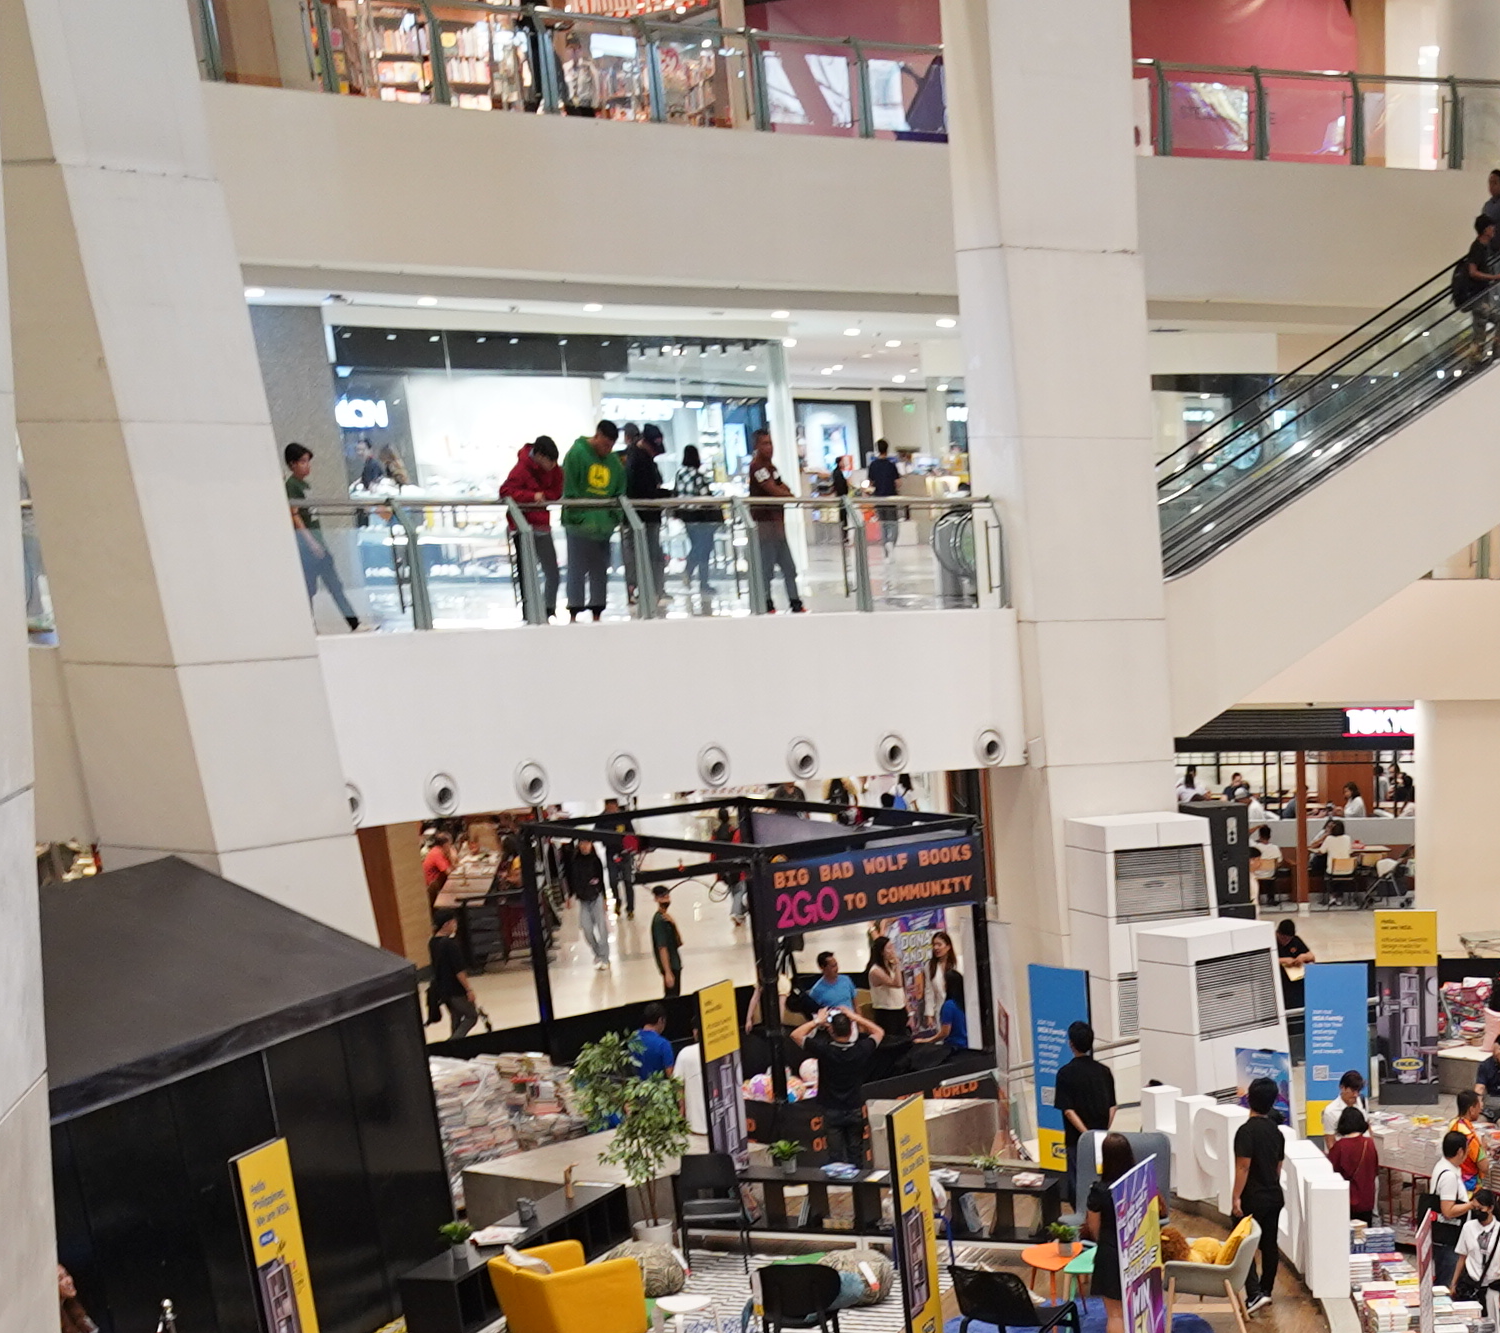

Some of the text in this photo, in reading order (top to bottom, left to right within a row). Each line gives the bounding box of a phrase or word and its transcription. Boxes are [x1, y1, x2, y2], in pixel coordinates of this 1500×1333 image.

[773, 843, 972, 889] BIG BAD WOLF BOOKS
[775, 874, 973, 929] 2GO TO COMMUNITY
[1395, 1059, 1422, 1070] IKEA
[932, 1081, 979, 1099] WORLD
